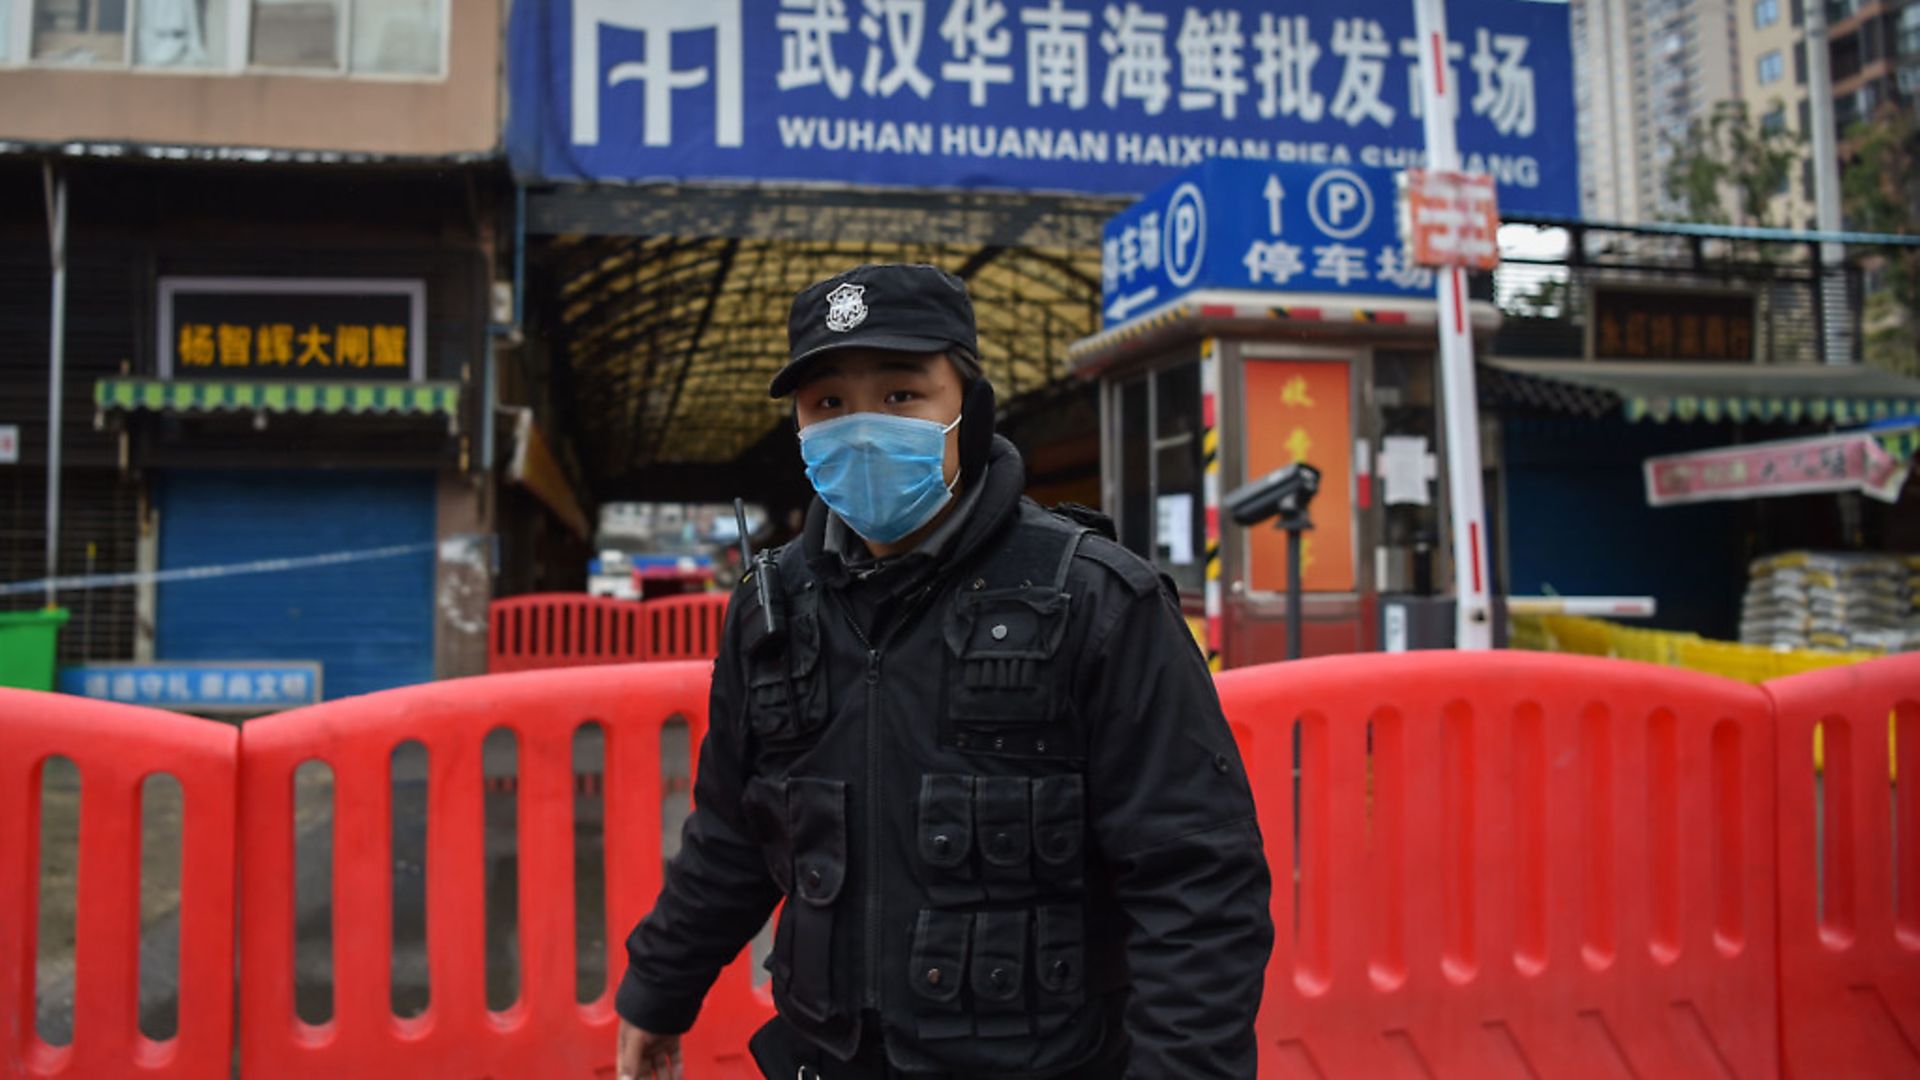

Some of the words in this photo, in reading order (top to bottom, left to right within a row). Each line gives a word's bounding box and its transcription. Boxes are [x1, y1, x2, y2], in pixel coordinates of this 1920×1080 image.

[778, 115, 932, 154] WUHAN
[942, 124, 1107, 163] HUANAN
[1116, 131, 1268, 167] HAIXIAN
